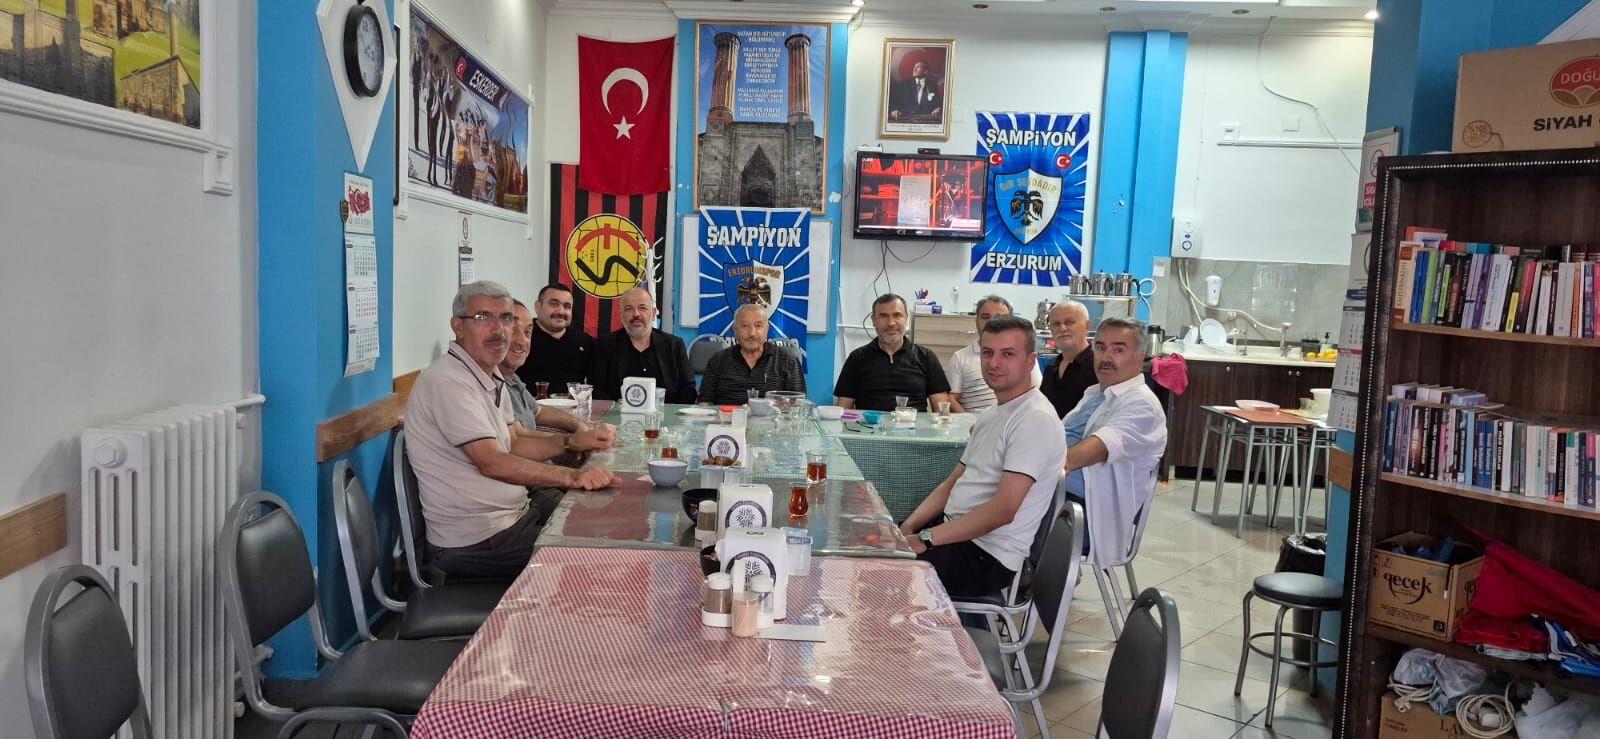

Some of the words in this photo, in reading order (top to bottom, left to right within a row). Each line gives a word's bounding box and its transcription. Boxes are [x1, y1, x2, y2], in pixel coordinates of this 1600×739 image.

[1560, 70, 1600, 85] DOĞU
[707, 224, 801, 248] ŞAMPİYON
[986, 252, 1062, 271] ERZURUM
